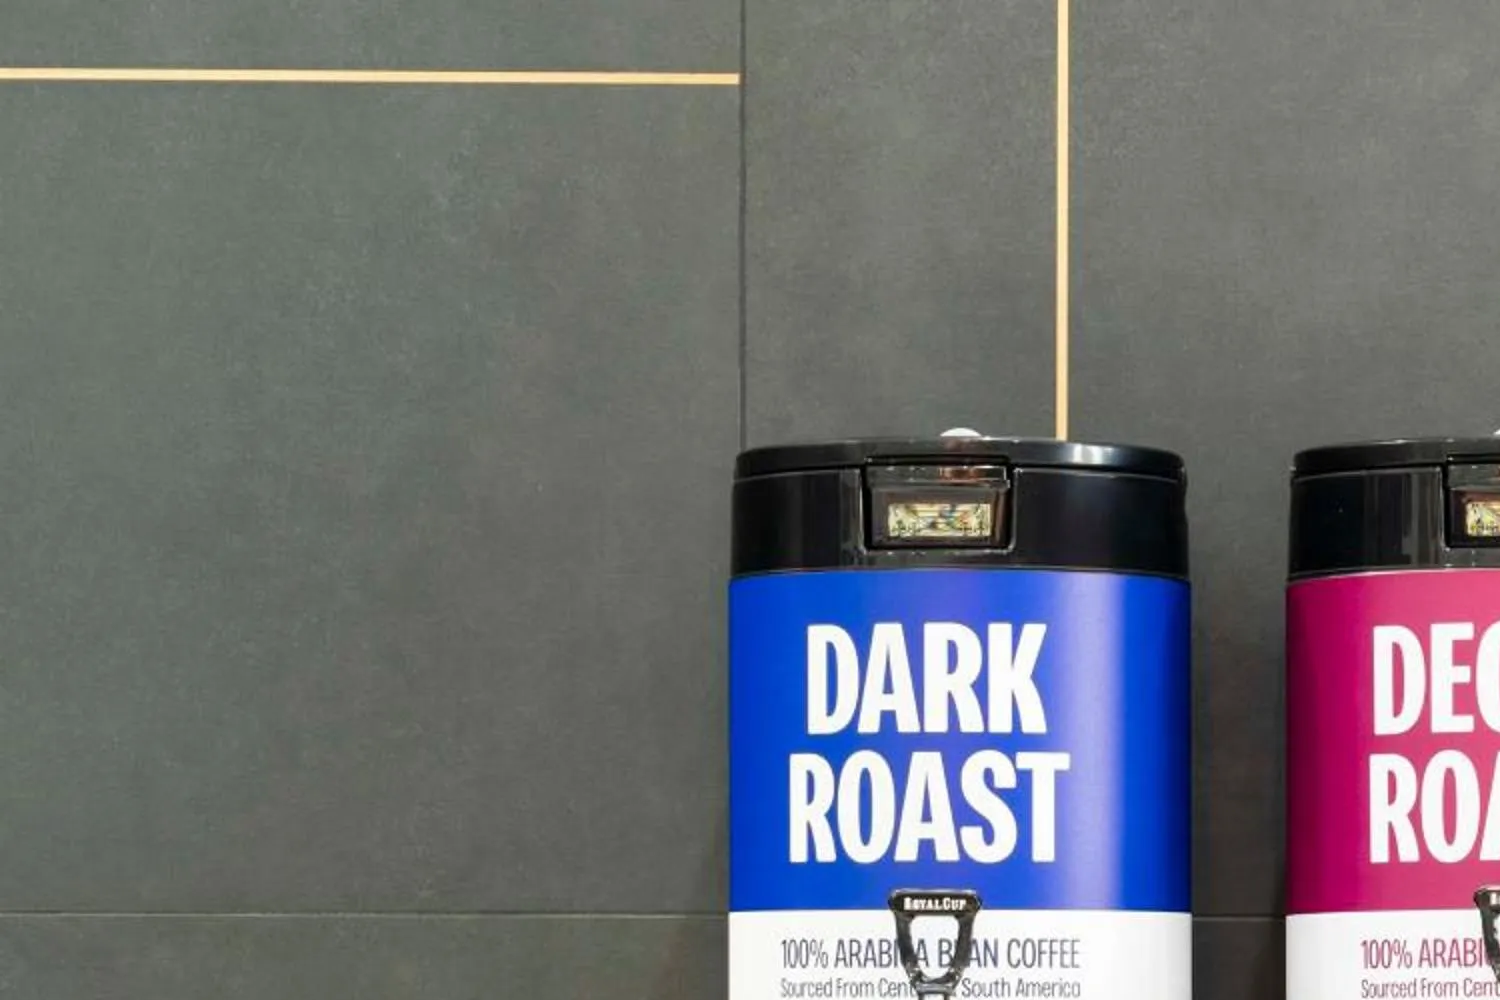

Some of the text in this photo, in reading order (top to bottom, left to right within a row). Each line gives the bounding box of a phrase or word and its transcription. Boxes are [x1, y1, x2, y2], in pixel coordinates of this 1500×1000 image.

[806, 621, 1048, 735] DARK
[788, 749, 1071, 864] ROAST
[781, 937, 1081, 969] 100% ARABIA BAN COFFEE
[1361, 938, 1413, 969] 100%
[780, 977, 833, 999] Sourced
[836, 977, 875, 998] From
[961, 977, 1011, 998] South
[1015, 977, 1081, 998] America
[1361, 977, 1417, 999] Sourced
[1420, 977, 1460, 998] From
